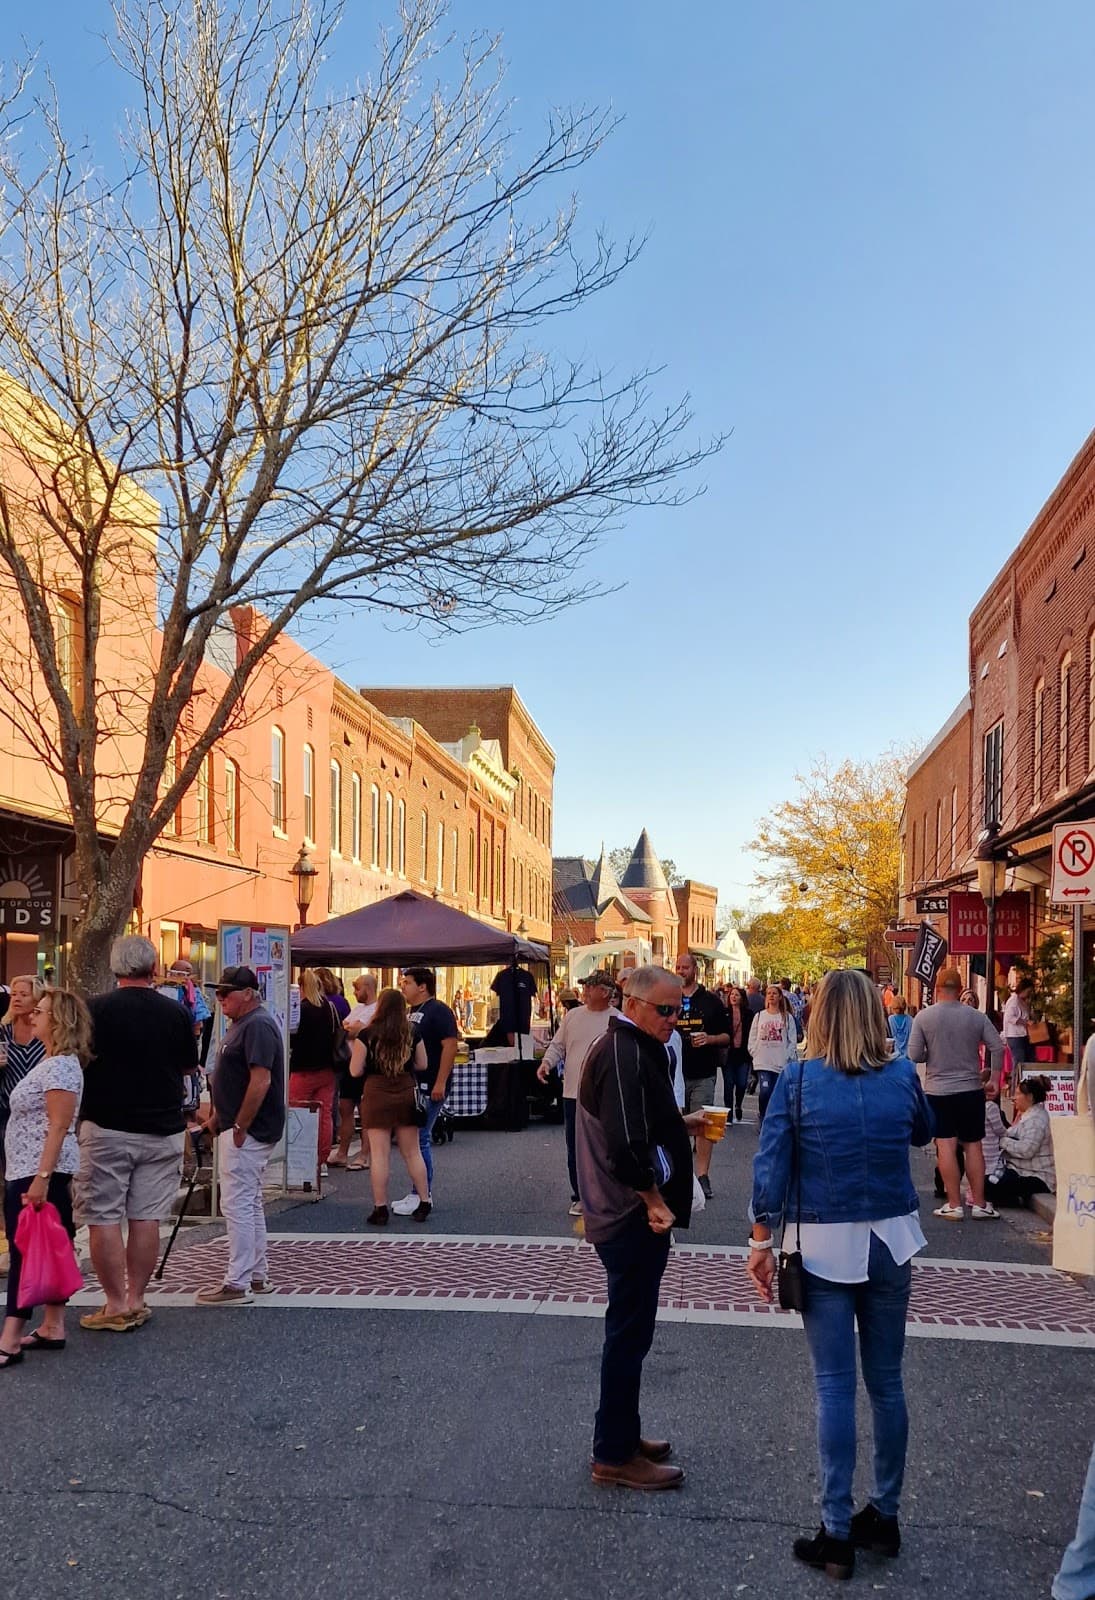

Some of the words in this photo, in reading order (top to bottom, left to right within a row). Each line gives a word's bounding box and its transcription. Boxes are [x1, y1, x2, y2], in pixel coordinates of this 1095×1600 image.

[0, 908, 52, 925] IDS
[1058, 1082, 1074, 1092] laid
[1048, 1102, 1065, 1112] Bad
